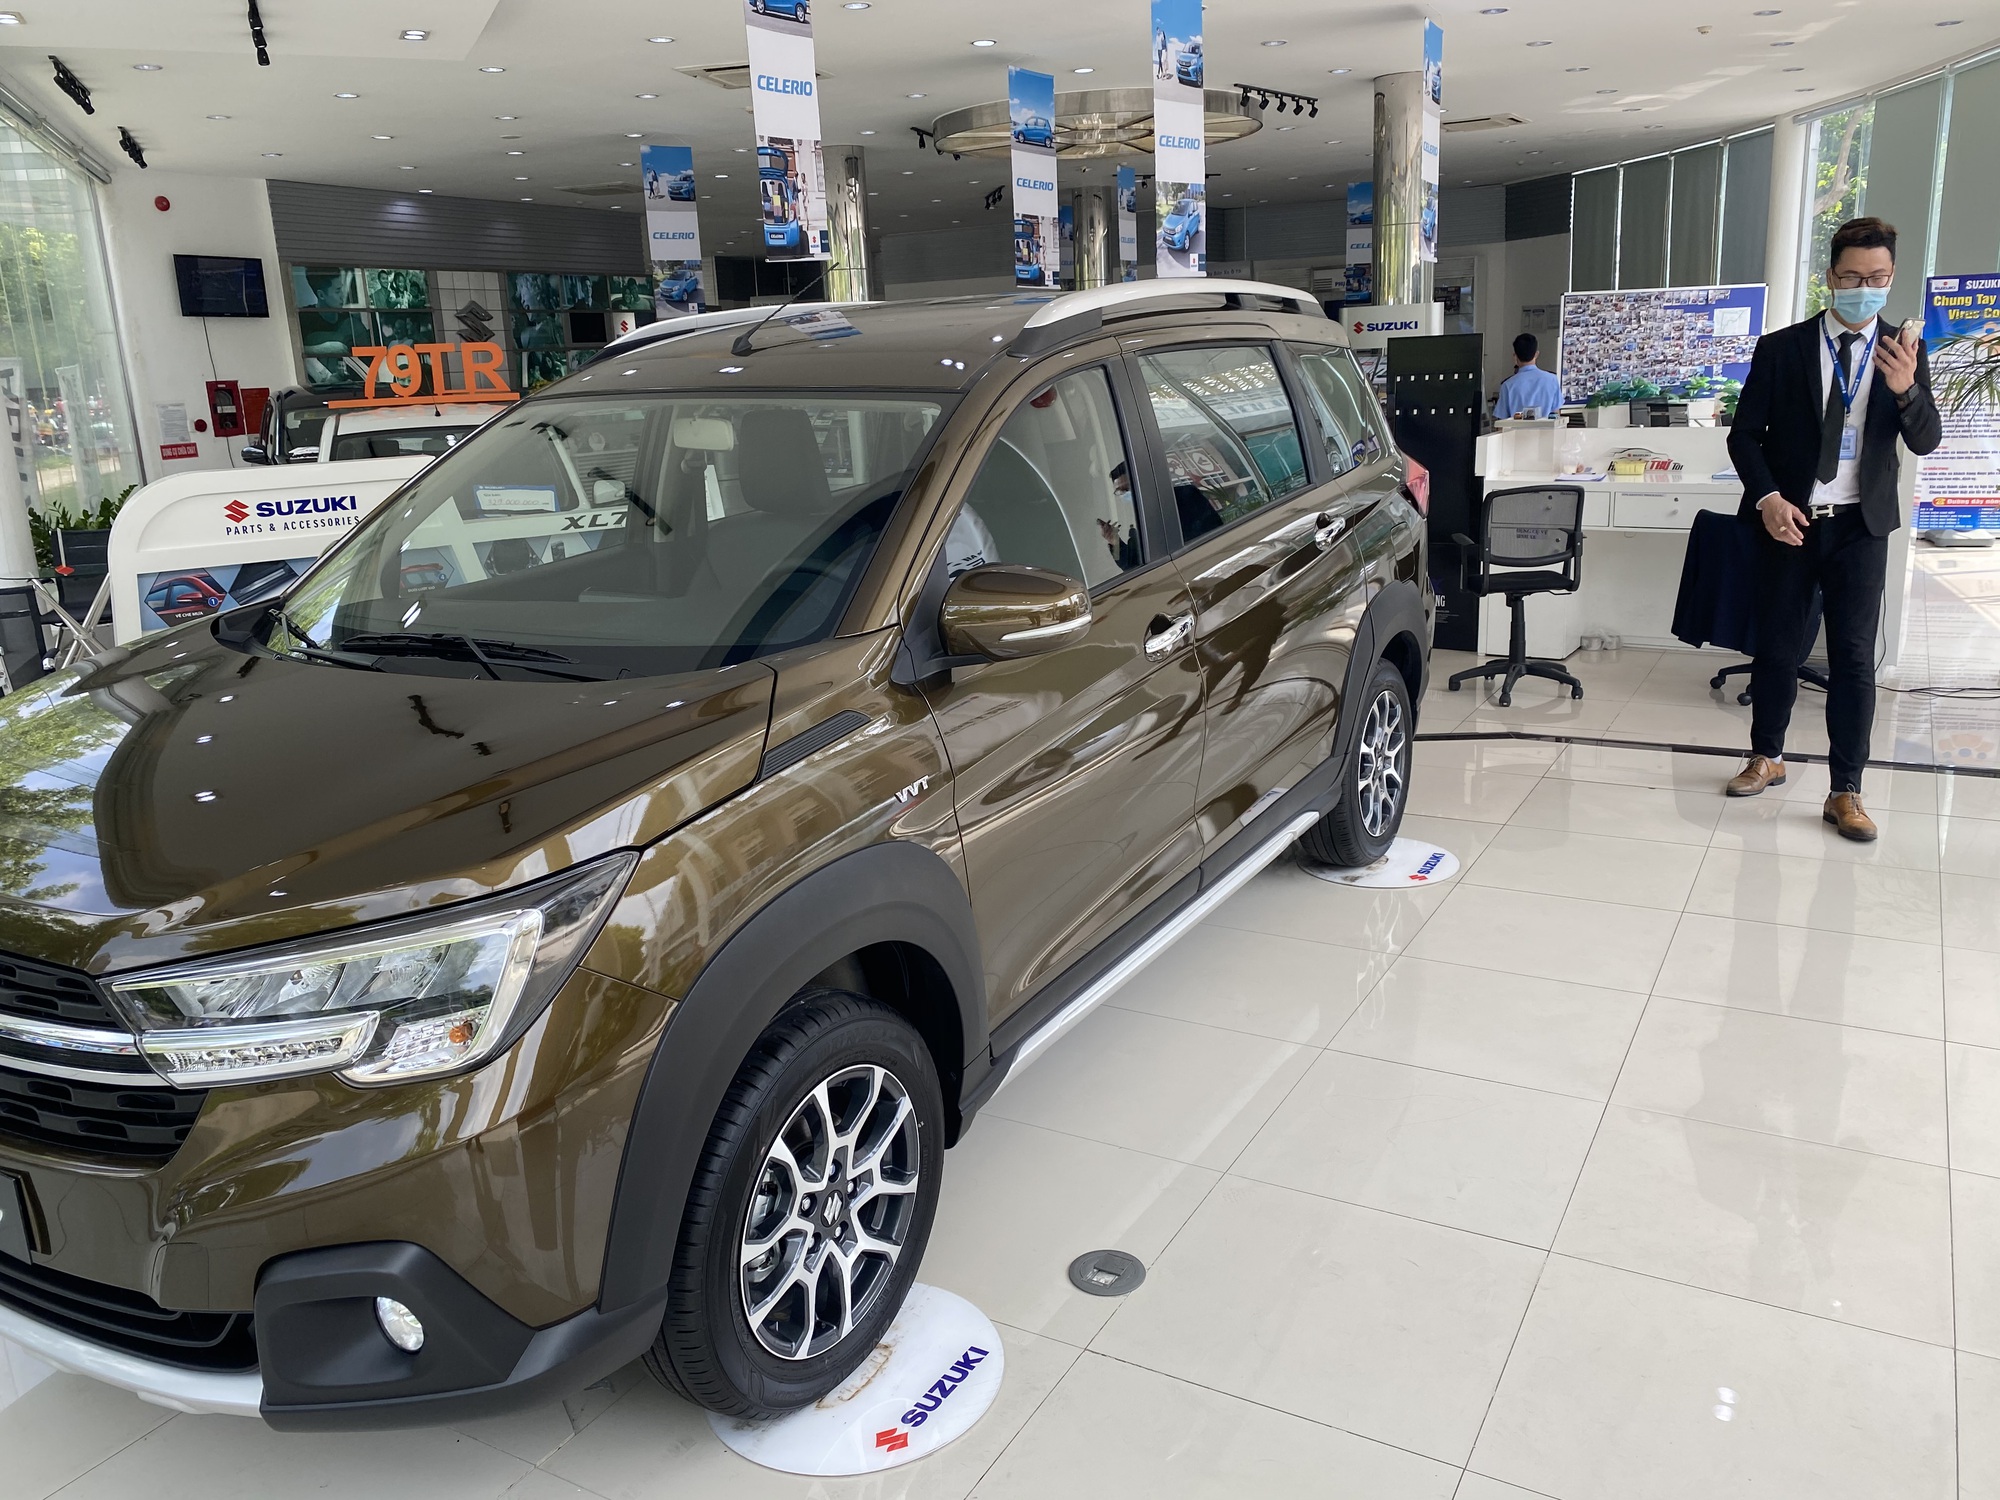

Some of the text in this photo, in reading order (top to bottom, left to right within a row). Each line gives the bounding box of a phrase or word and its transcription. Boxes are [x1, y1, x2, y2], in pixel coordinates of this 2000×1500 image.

[757, 74, 813, 97] CELERIO
[1159, 134, 1201, 151] CELERIO
[1423, 141, 1438, 157] CELERIO
[1016, 177, 1054, 192] CELERIO
[652, 231, 695, 241] CELERIO
[1933, 294, 1997, 306] Chung Tay
[1366, 320, 1418, 332] SUZUKI
[352, 341, 511, 398] 79TR
[256, 495, 357, 518] SUZUKI
[226, 515, 360, 536] PARTS & ACCESSORIES
[560, 511, 628, 531] XL7
[894, 775, 929, 803] VVT
[1417, 852, 1446, 875] SUZUKI
[900, 1345, 990, 1428] SUZUKI
